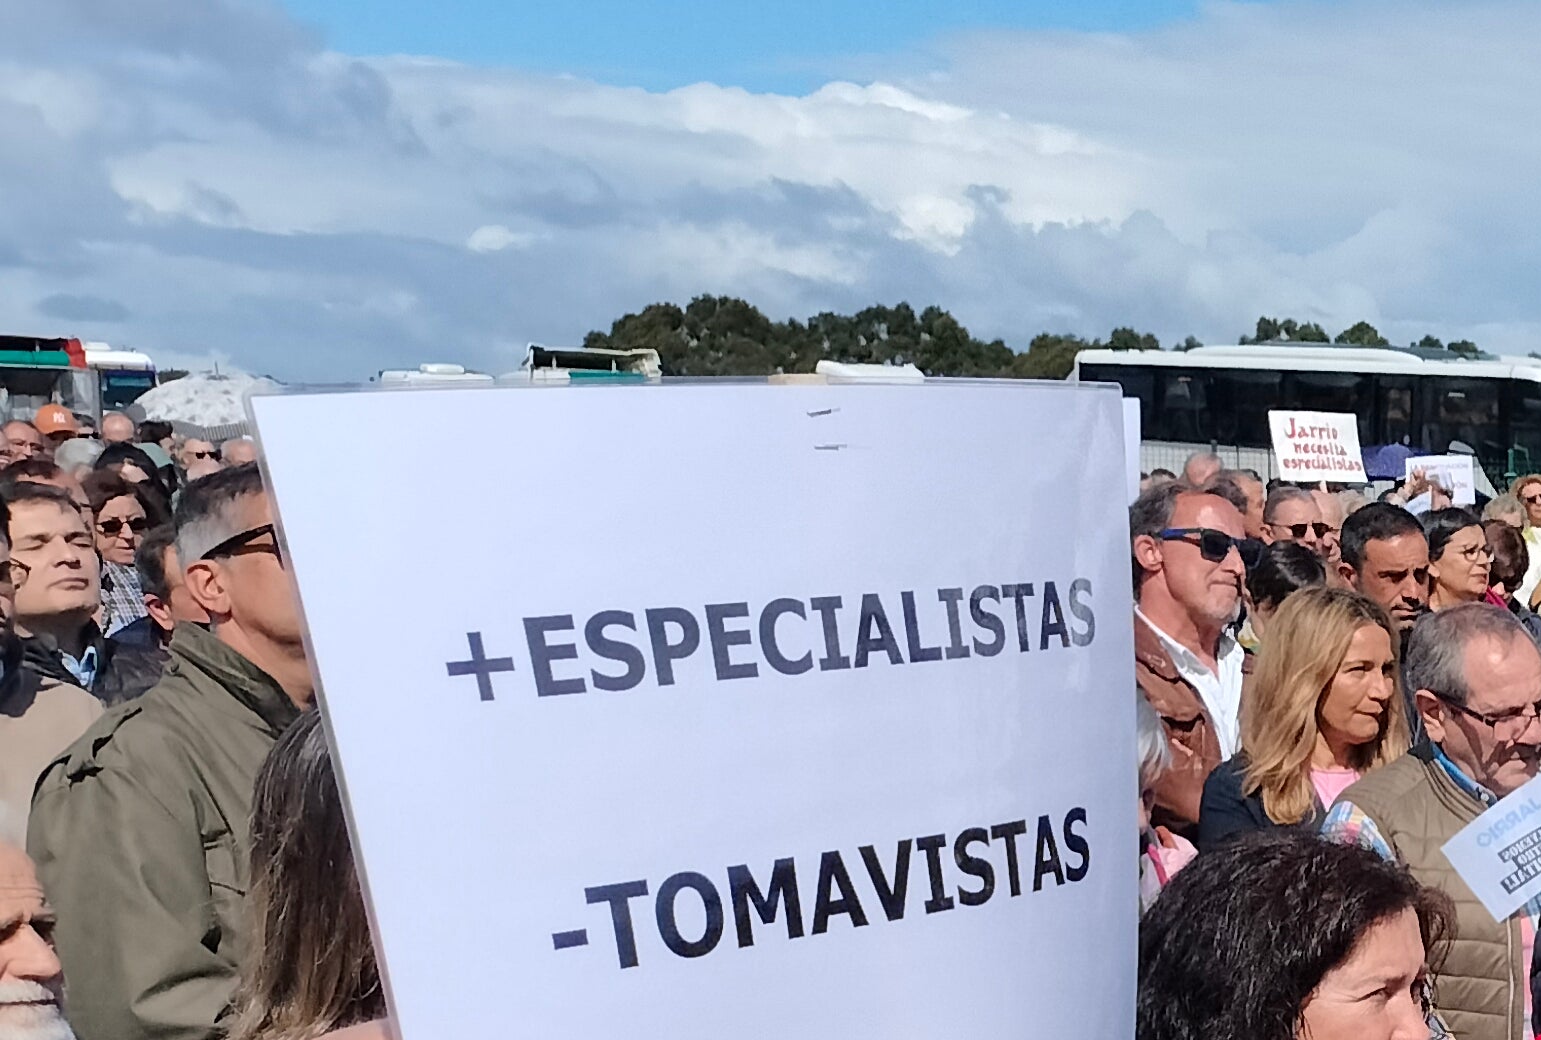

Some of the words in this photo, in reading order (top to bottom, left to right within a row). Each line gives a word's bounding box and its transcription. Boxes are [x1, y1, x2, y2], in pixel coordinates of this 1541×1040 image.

[1284, 417, 1339, 440] Jarrio
[1293, 441, 1348, 456] necesita
[1283, 454, 1362, 471] especialistas
[446, 577, 1097, 702] +ESPECIALISTAS
[552, 806, 1091, 969] -TOMAVISTAS
